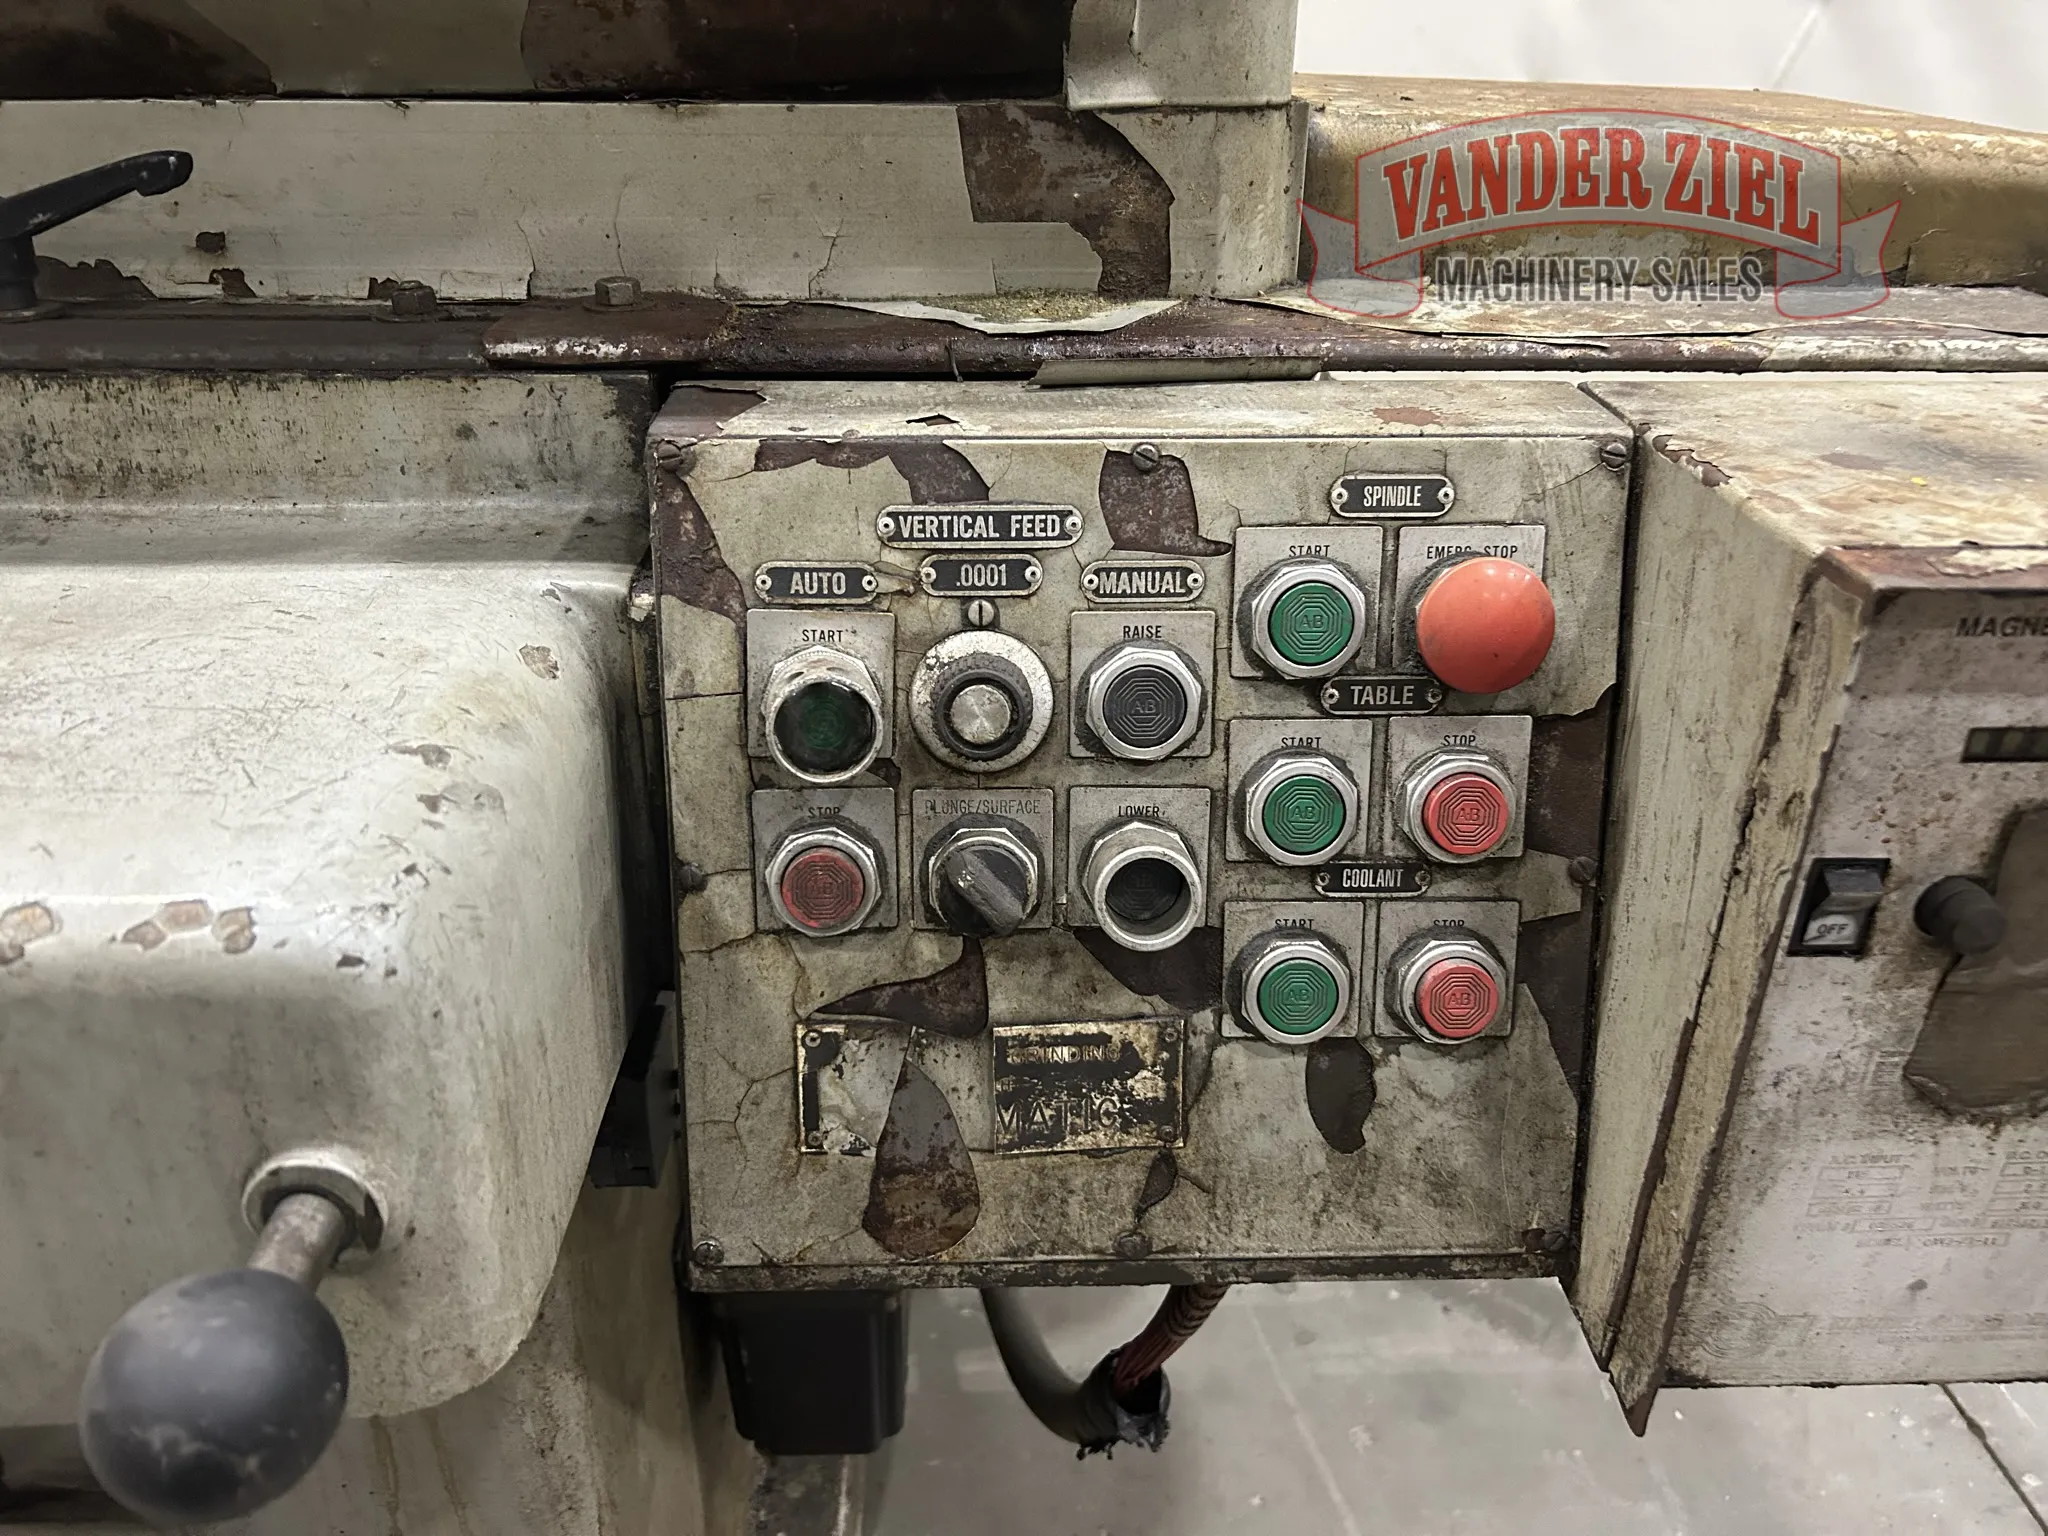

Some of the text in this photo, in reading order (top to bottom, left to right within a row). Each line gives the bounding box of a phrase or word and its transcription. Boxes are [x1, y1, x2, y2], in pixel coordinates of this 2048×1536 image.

[1363, 485, 1422, 507] SPINDLE
[899, 514, 1061, 538] VERTICAL FEED
[1289, 545, 1331, 558] START
[1483, 545, 1518, 559] STOP
[789, 572, 847, 594] AUTO
[955, 565, 1008, 587] .0001
[1099, 571, 1186, 594] MANUAL
[801, 629, 844, 643] START
[1123, 625, 1162, 640] RAISE
[1350, 685, 1414, 705] TABLE
[1281, 736, 1322, 749] START
[1443, 735, 1476, 747] STOP
[808, 805, 841, 818] STOP
[1118, 805, 1160, 819] LOWER
[1342, 868, 1404, 888] COOLANT
[1817, 923, 1849, 934] OFF
